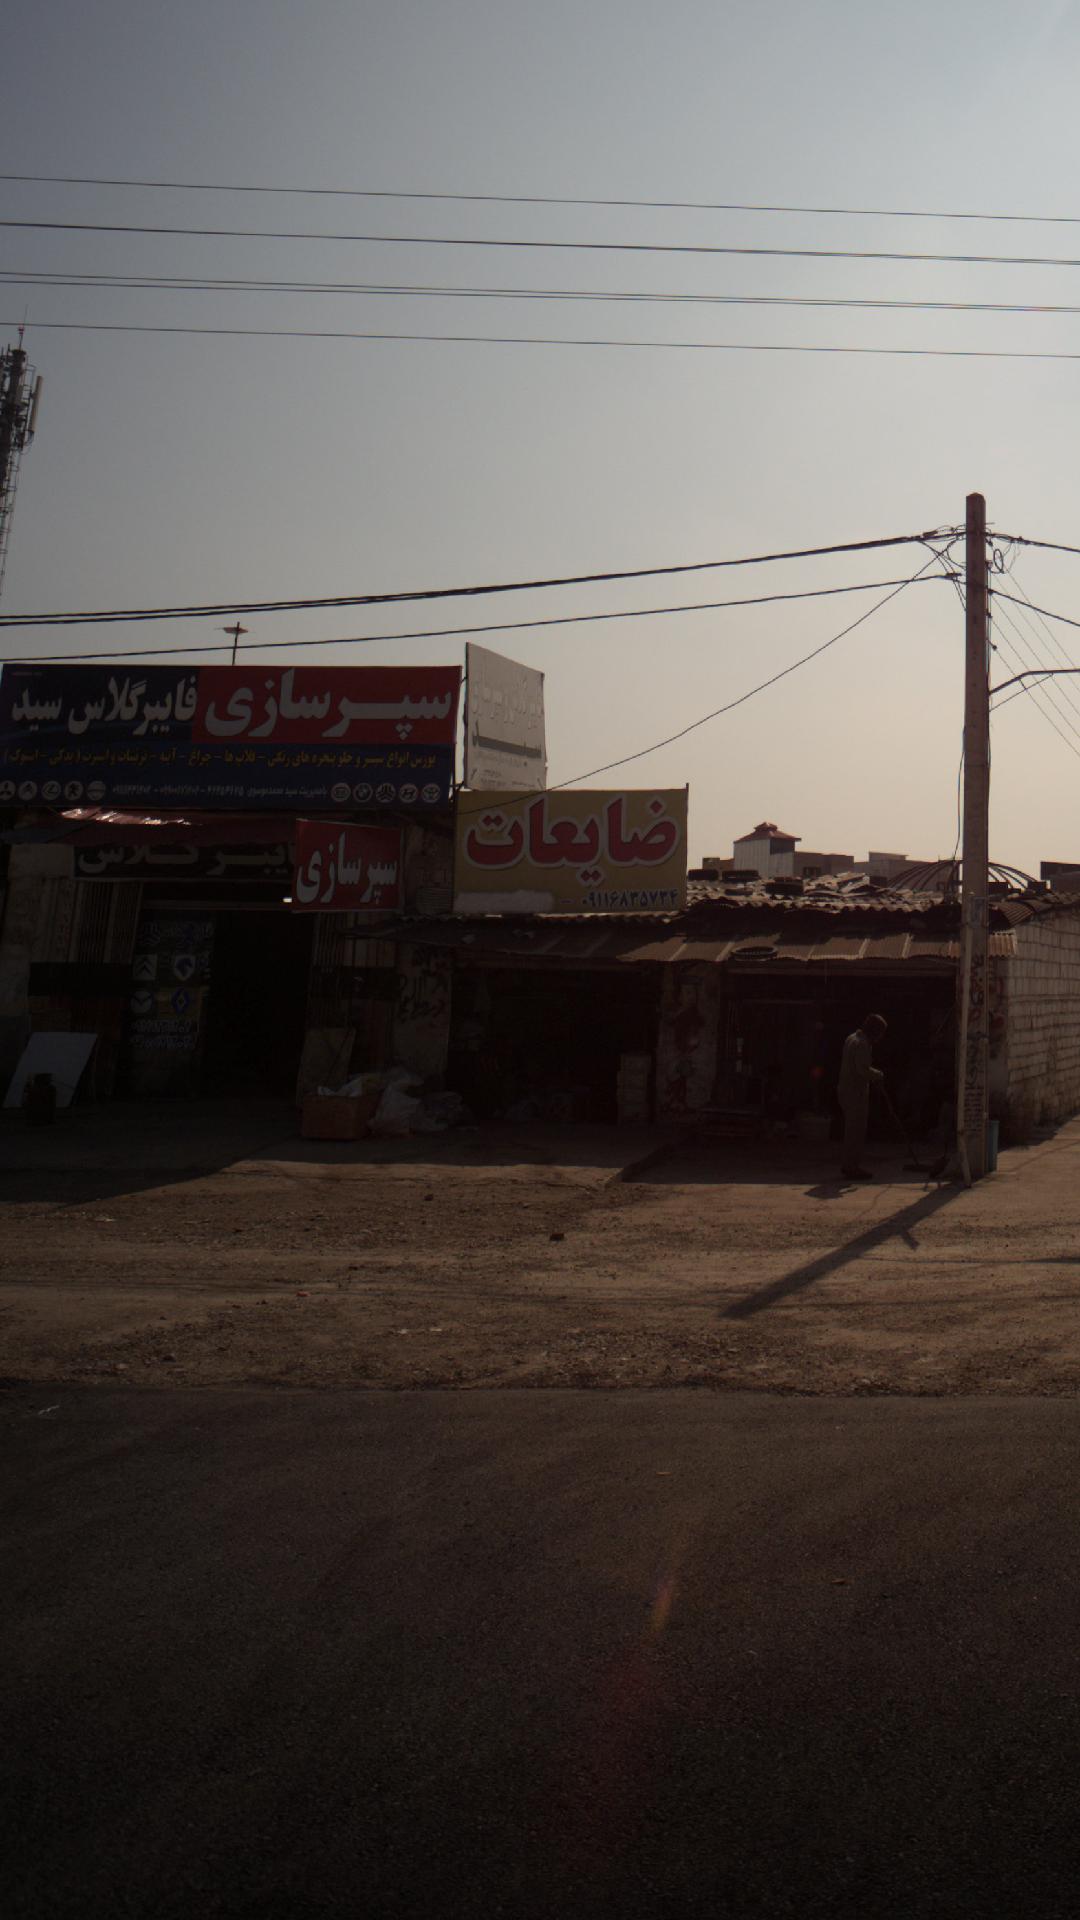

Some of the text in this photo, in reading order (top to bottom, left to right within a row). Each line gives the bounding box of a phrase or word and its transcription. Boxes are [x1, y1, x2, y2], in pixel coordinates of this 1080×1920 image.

[11, 687, 62, 731] سید
[187, 749, 212, 768] چراغ
[386, 751, 409, 769] انواع
[465, 797, 679, 882] ضایعات
